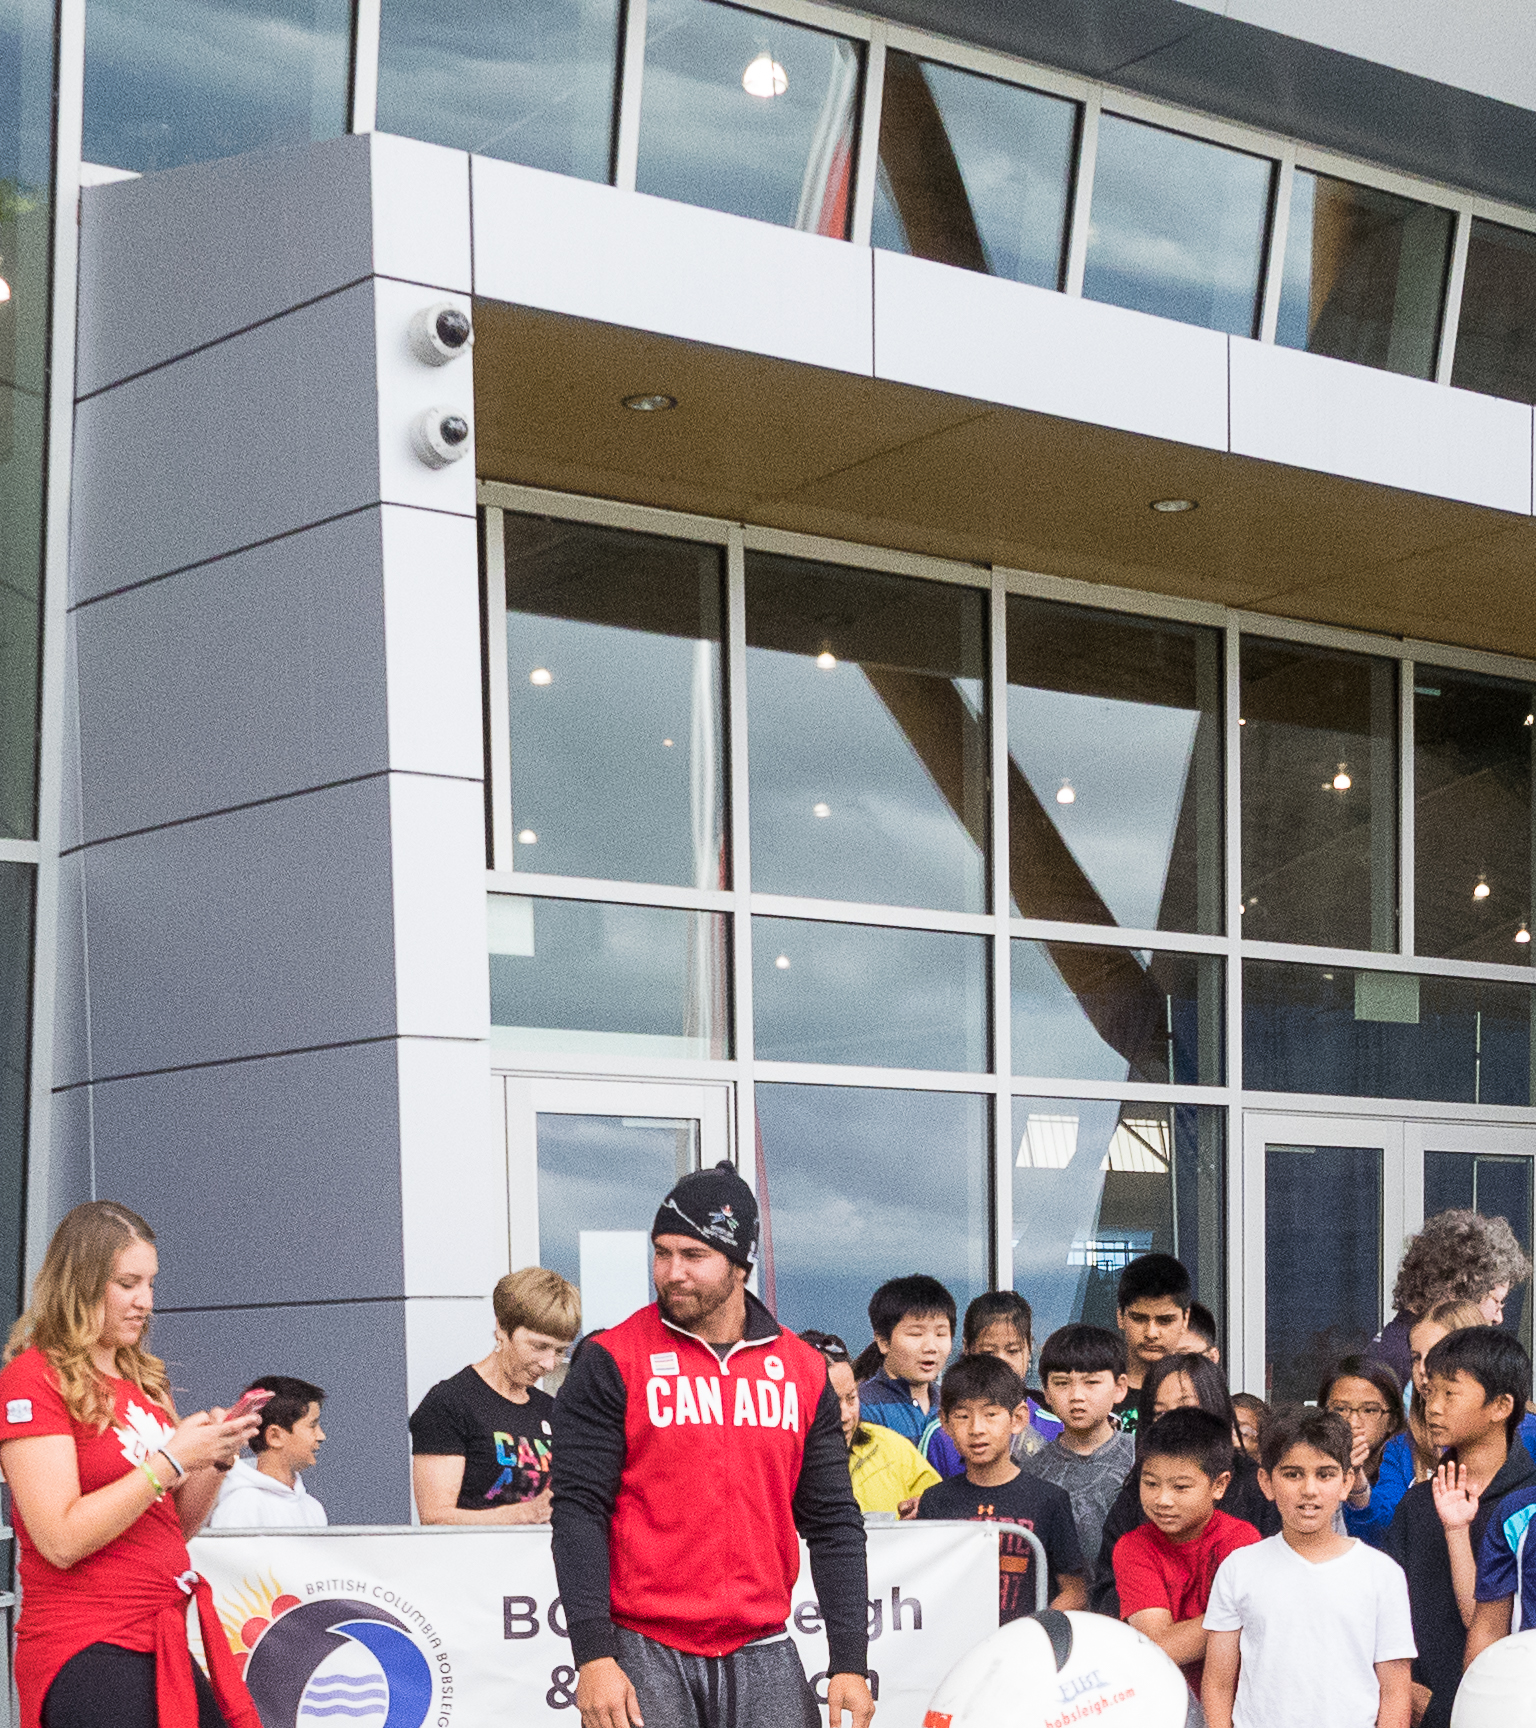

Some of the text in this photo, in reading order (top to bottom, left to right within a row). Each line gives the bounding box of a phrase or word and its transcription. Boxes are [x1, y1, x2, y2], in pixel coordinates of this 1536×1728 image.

[646, 1376, 799, 1433] CANADA
[306, 1579, 367, 1595] BRITISH
[372, 1586, 442, 1649] COLUMBIA
